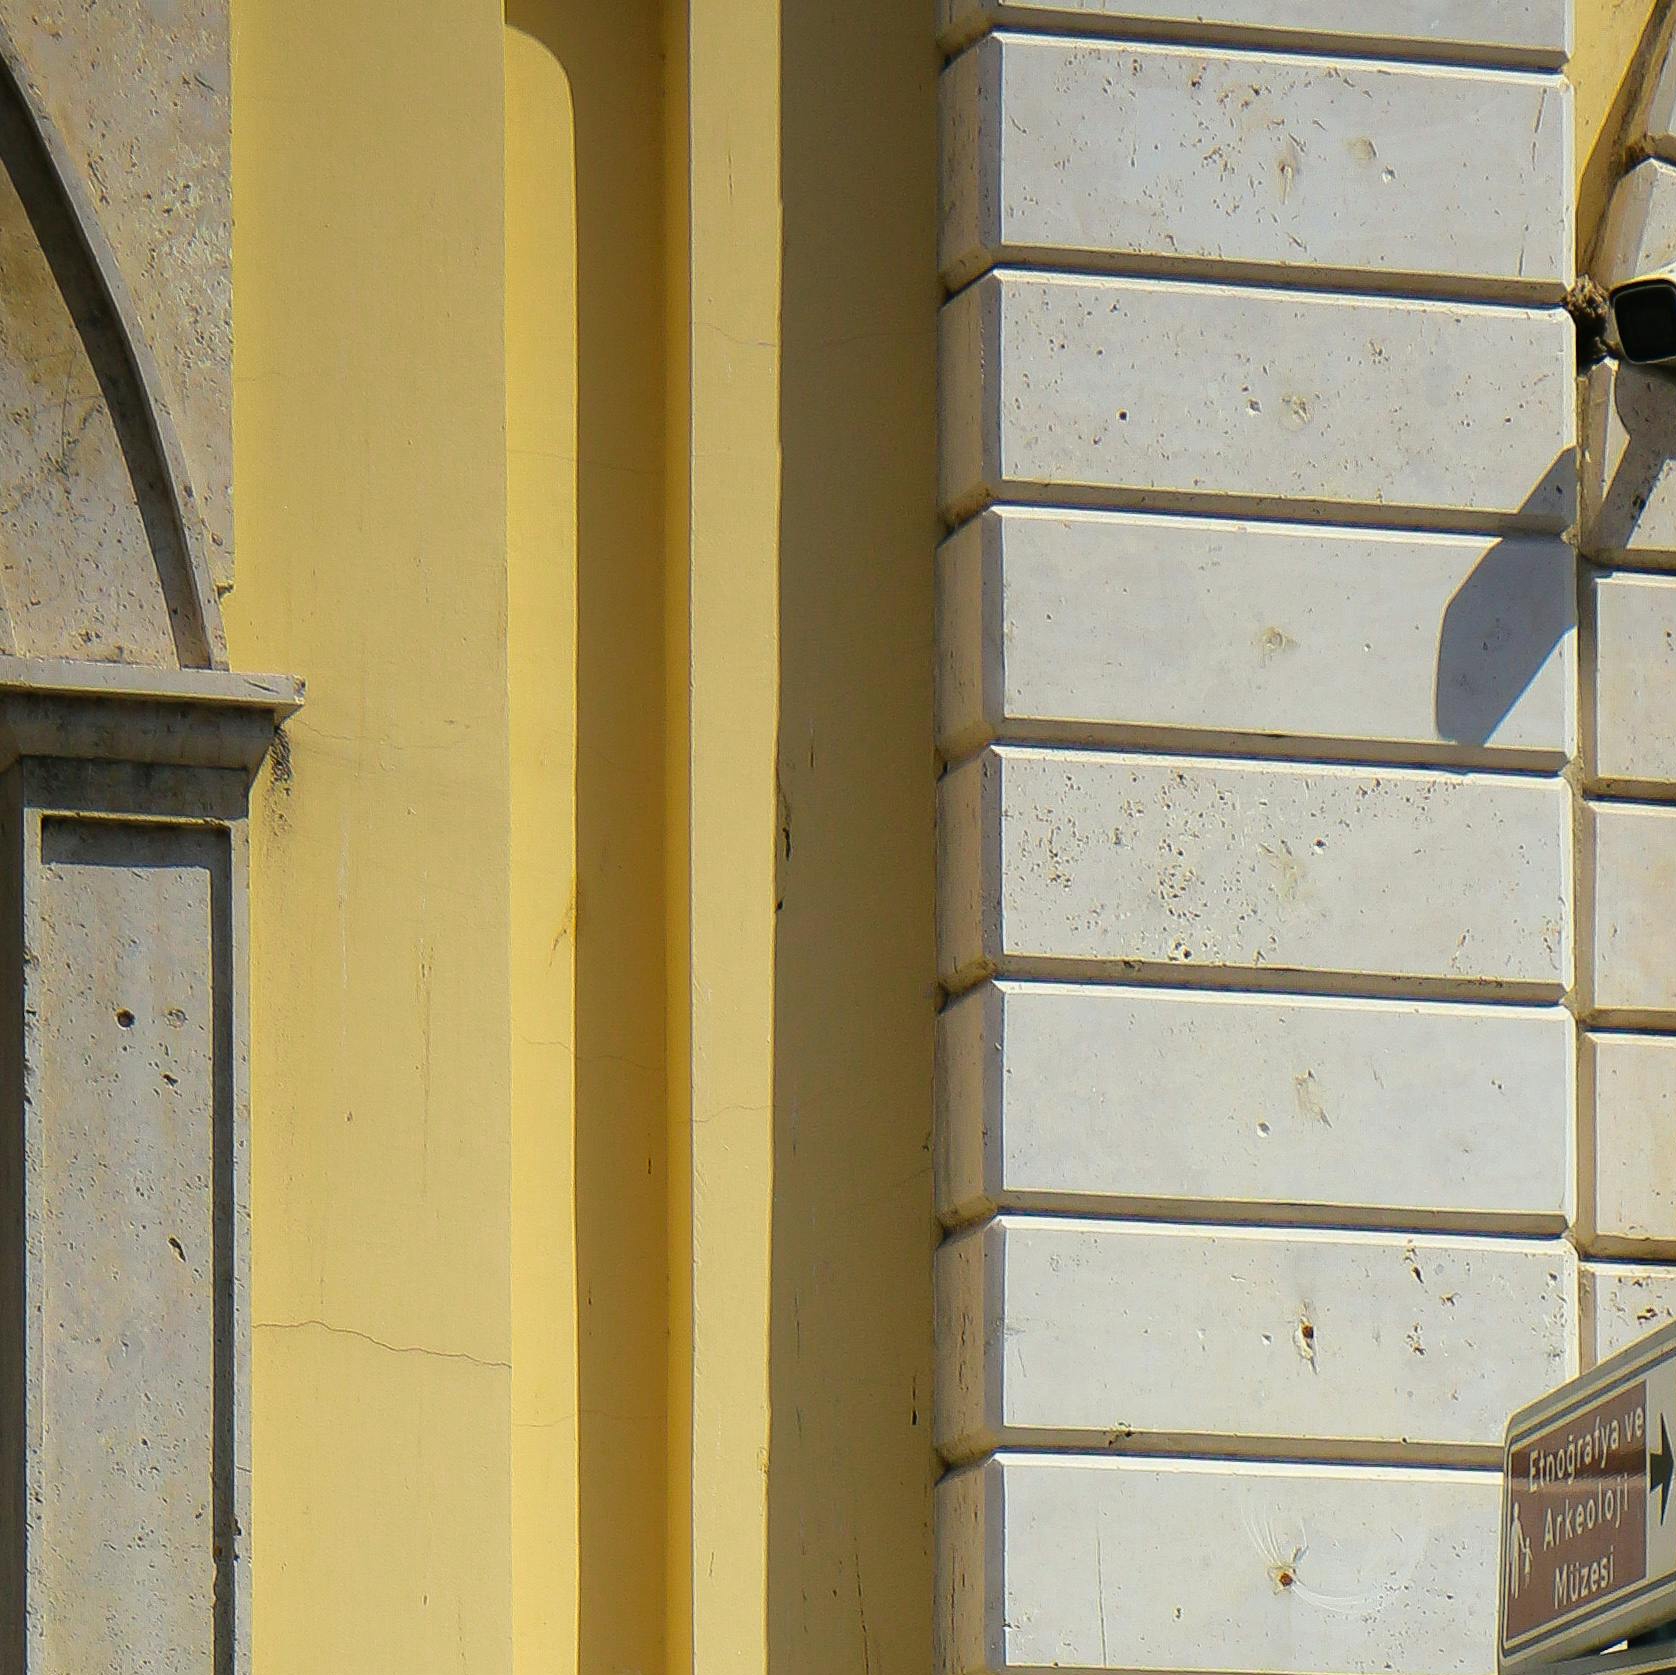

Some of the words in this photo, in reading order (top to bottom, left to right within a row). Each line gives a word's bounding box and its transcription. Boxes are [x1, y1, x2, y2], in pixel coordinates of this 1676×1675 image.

[1528, 1415, 1620, 1494] Etnoğrafya
[1625, 1406, 1645, 1443] ve
[1543, 1474, 1629, 1551] Arkeoloji
[1554, 1546, 1614, 1609] Müzesi
